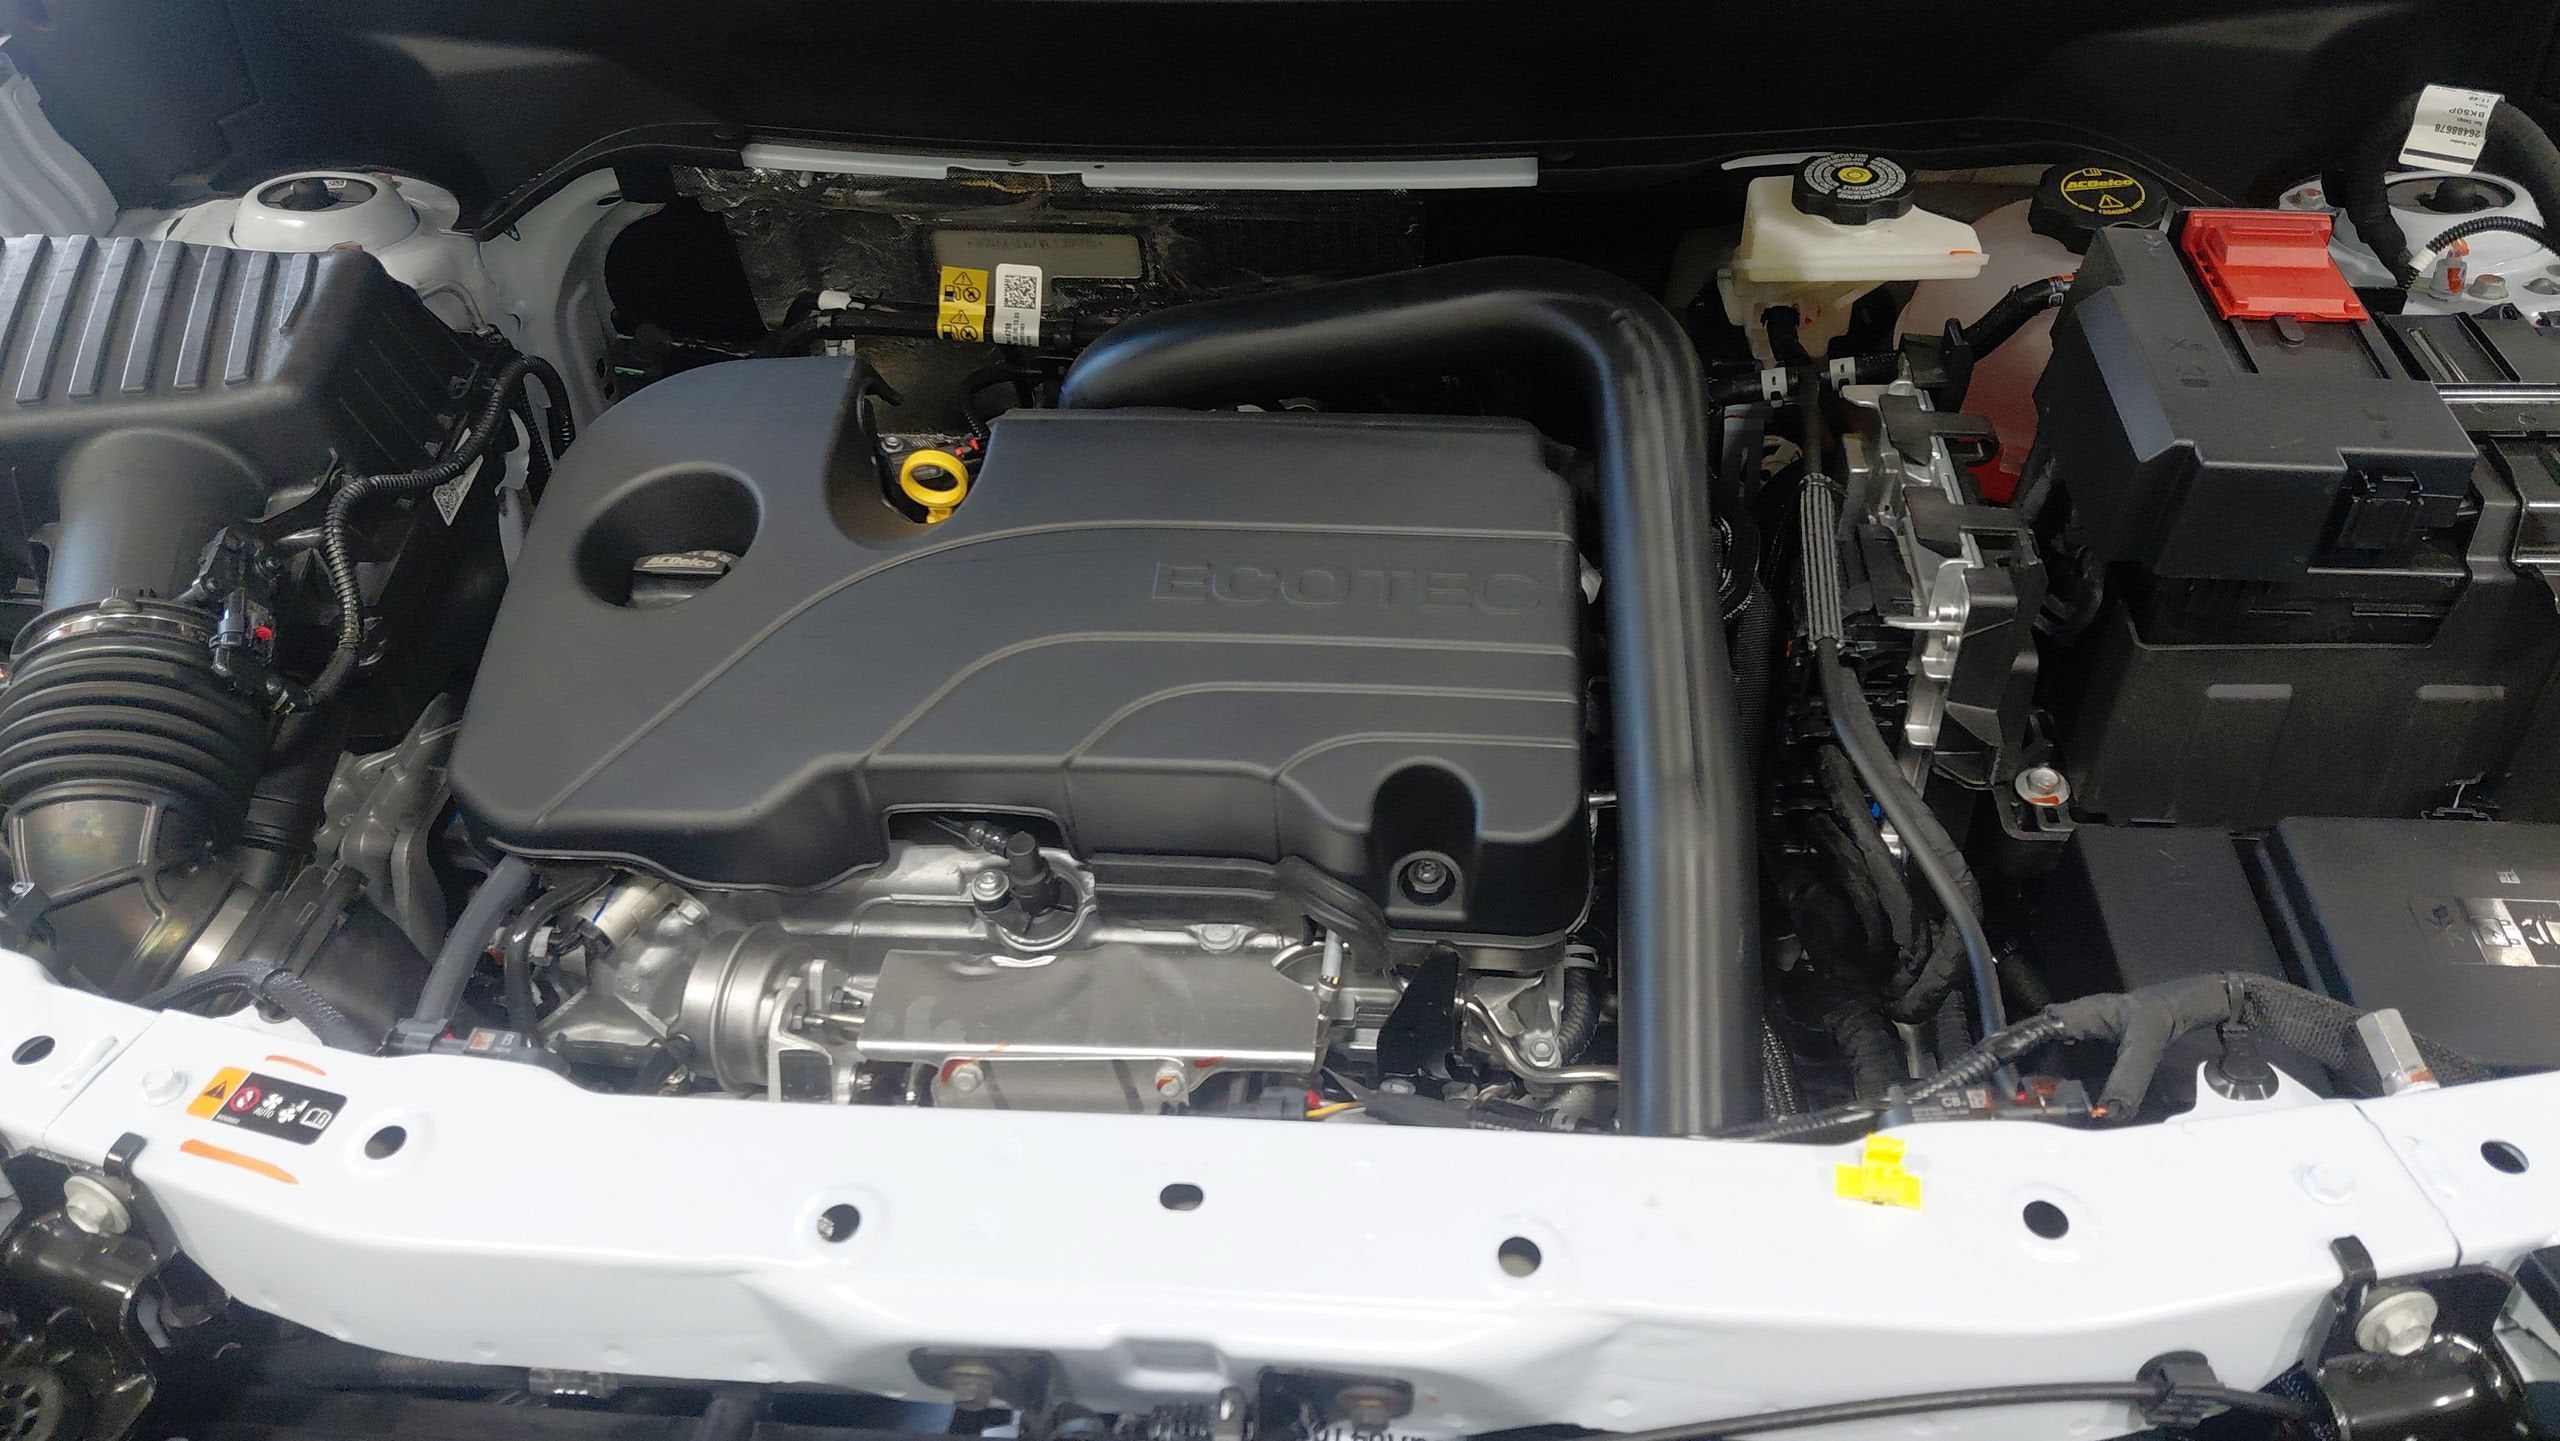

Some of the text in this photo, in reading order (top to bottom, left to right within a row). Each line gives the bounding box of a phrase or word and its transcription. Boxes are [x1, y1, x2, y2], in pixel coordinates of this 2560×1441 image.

[2434, 123, 2480, 138] 26488678
[2065, 179, 2133, 190] ACDelco
[642, 556, 717, 569] ACDelco
[1152, 561, 1541, 614] ECOTEC
[253, 1107, 274, 1119] AUTO
